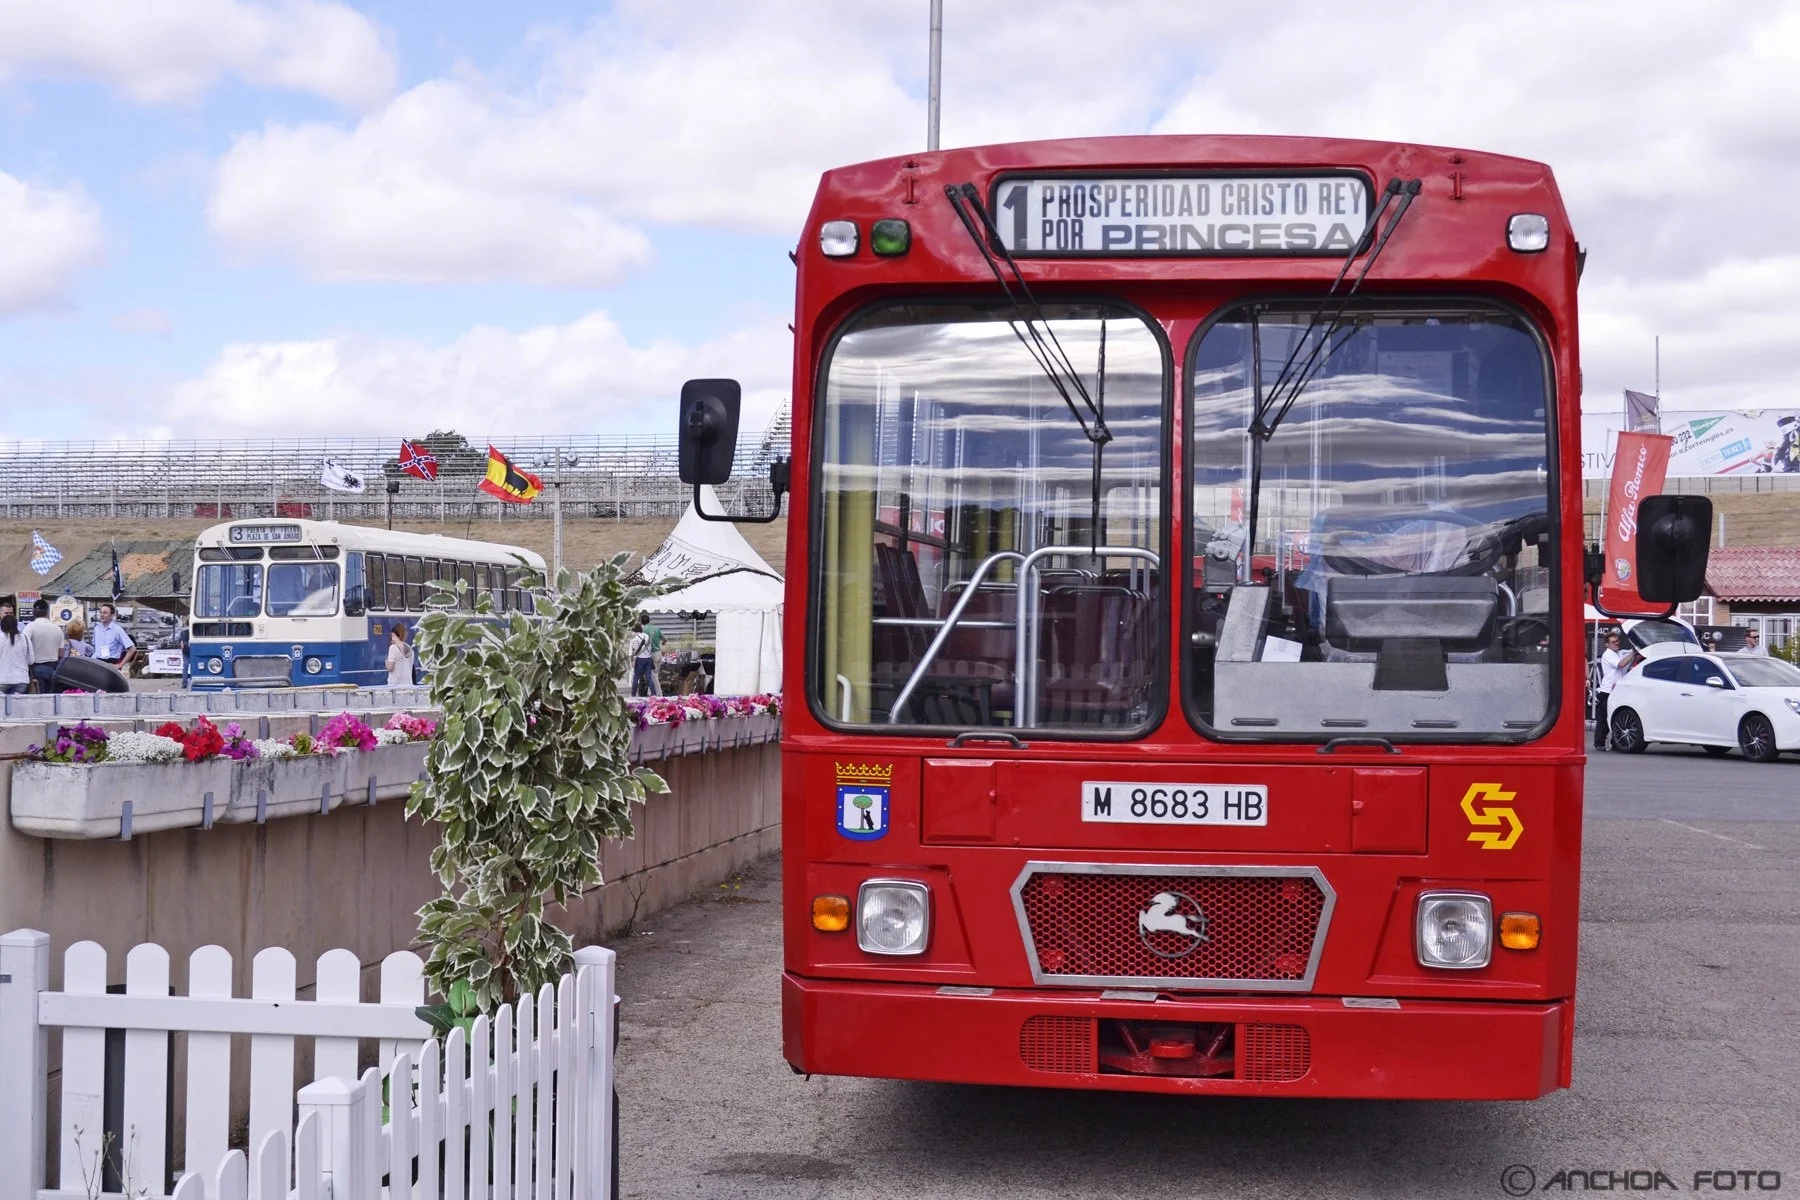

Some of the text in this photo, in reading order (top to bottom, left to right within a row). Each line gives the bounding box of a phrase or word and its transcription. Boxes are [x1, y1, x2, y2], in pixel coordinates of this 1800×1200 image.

[1003, 185, 1029, 250] 1
[1042, 182, 1364, 218] PROSPERIDAD CRISTO REY
[1042, 219, 1356, 250] POR PRINCESA
[1618, 443, 1647, 542] Alfa Romeo
[233, 527, 243, 540] 3
[1094, 787, 1263, 821] M 8683 HB
